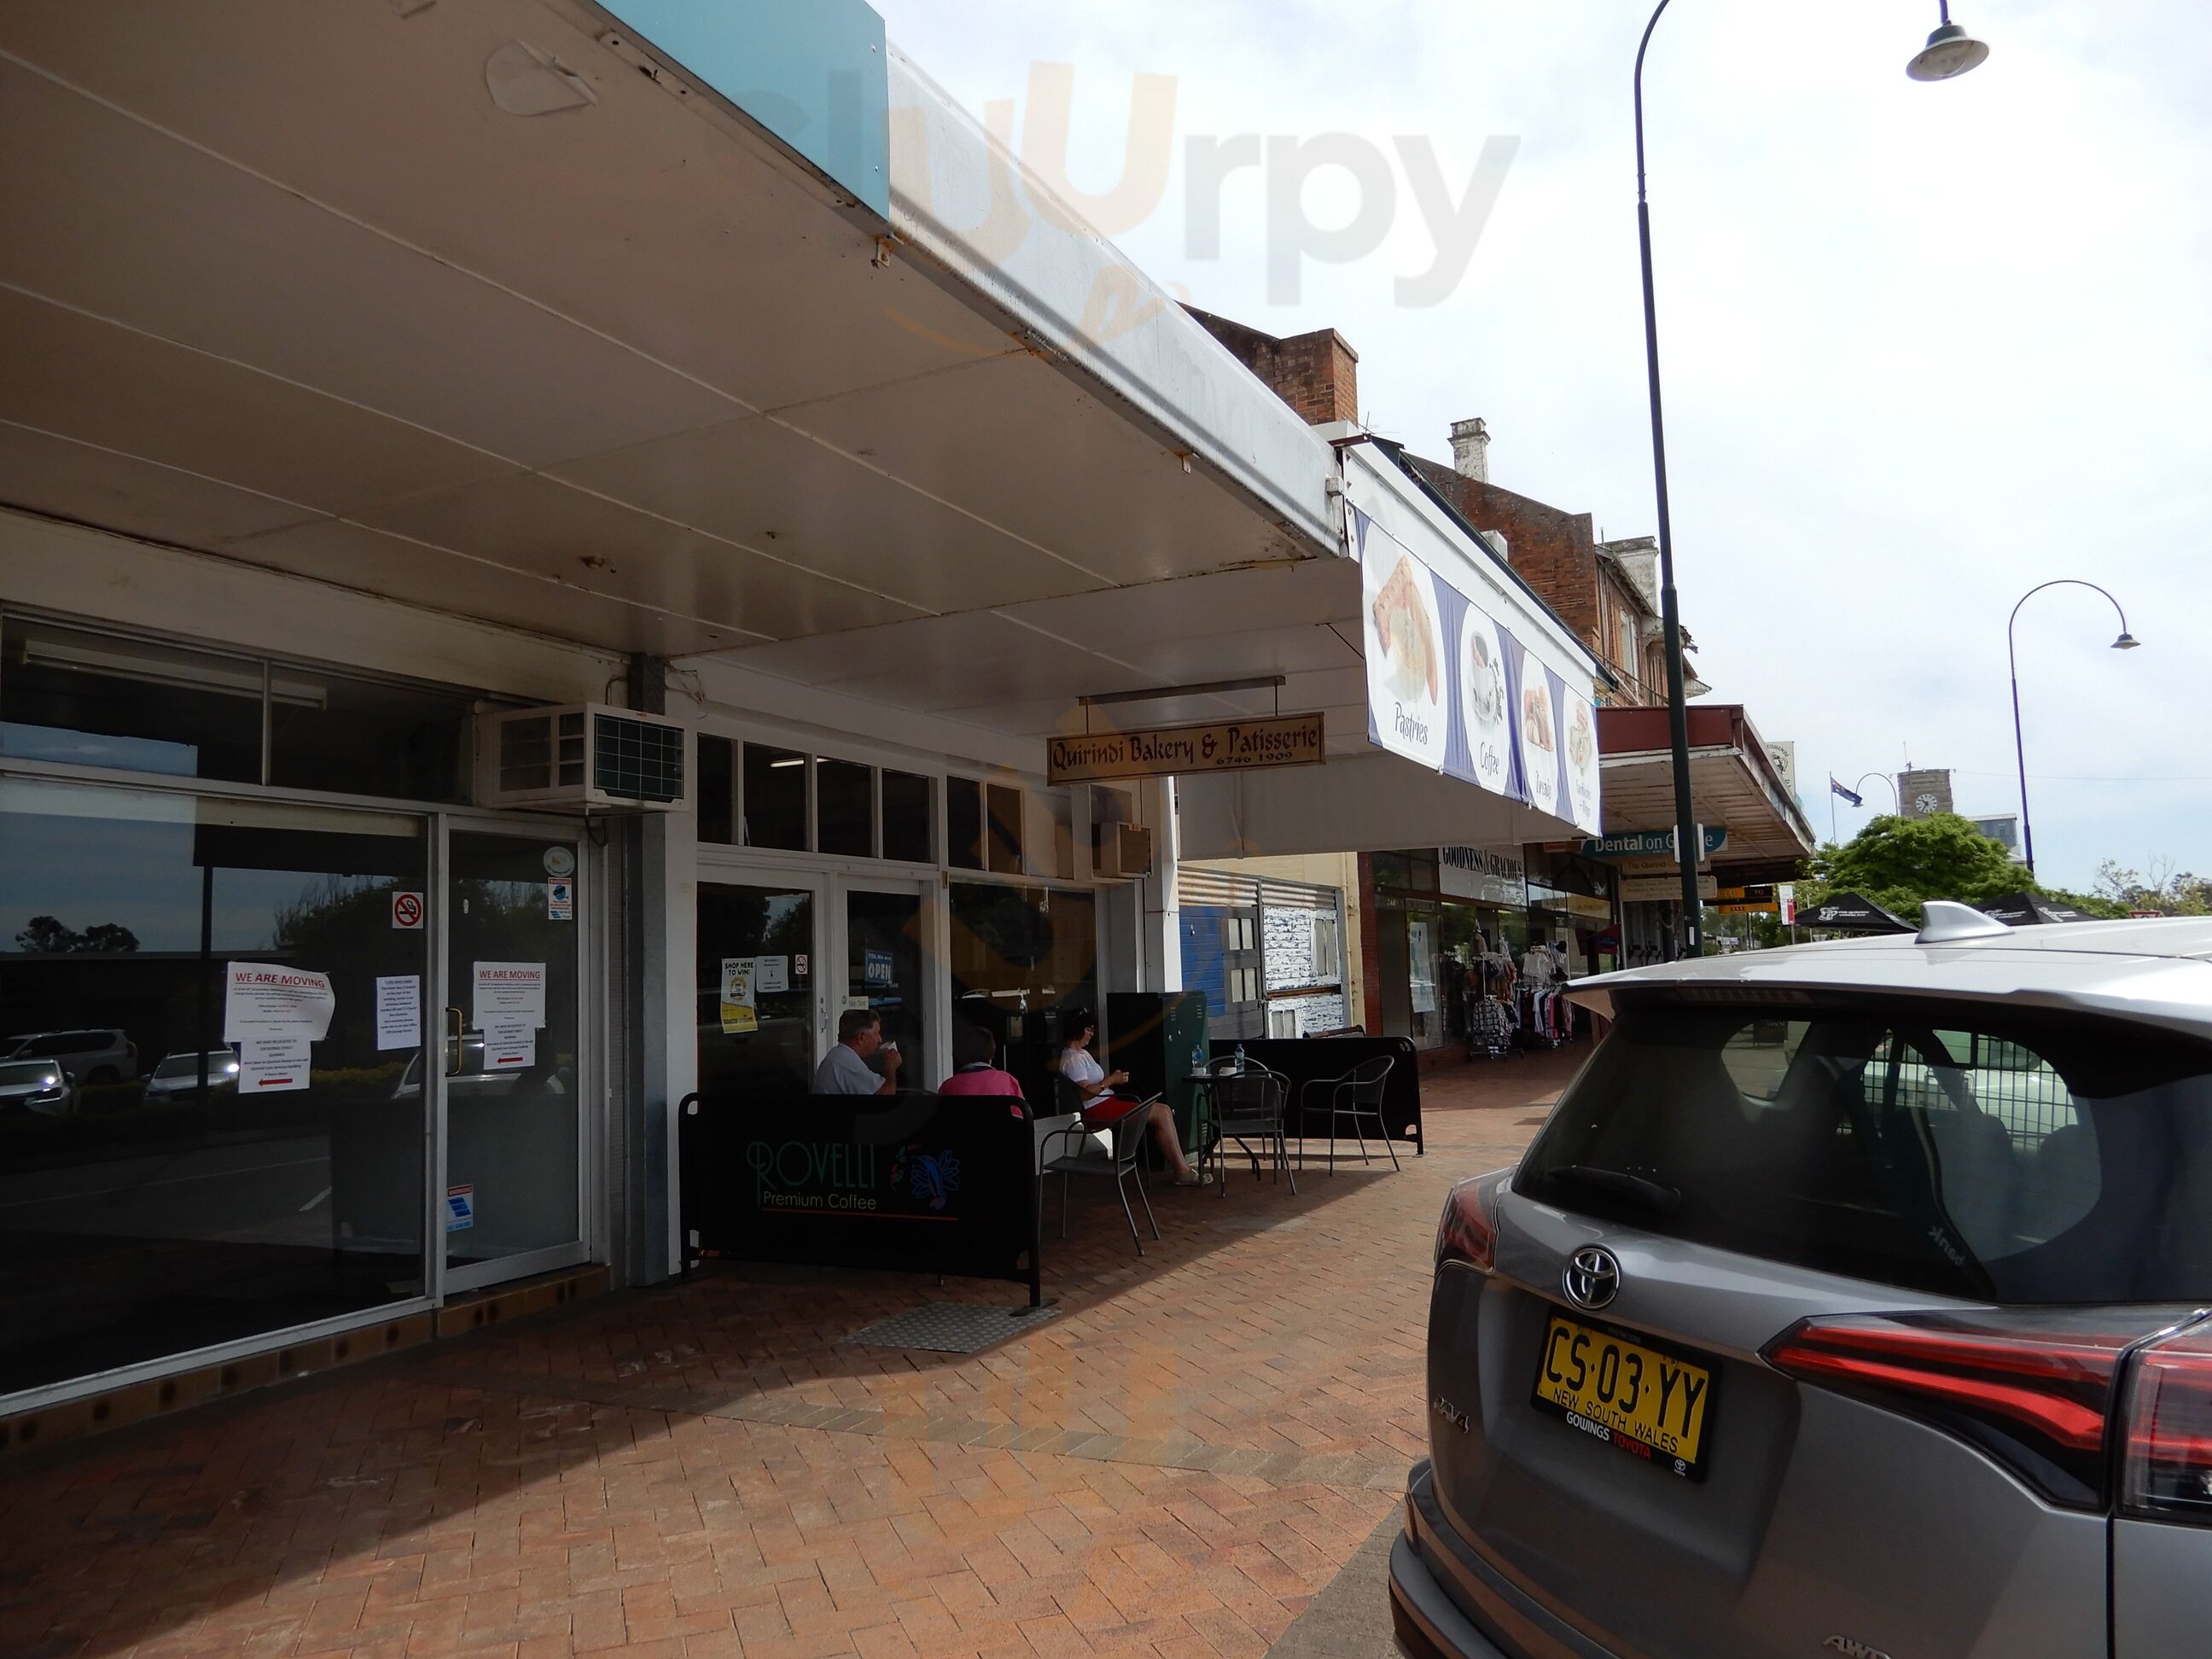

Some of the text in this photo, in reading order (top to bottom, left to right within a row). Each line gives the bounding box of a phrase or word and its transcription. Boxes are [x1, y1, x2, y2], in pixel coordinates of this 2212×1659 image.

[1394, 701, 1429, 743] Pastries
[1053, 724, 1317, 771] Quirindi Bakery & Patisserie
[1217, 751, 1293, 766] 6746 1909
[1480, 741, 1499, 776] Coffee
[1594, 834, 1644, 853] Dental
[1646, 837, 1663, 850] on
[1442, 847, 1523, 880] GOODNESS & GRACIOUS
[236, 972, 325, 988] WE ARE MOVING
[479, 970, 541, 979] WE ARE MOVING
[868, 962, 892, 981] OPEN
[746, 1140, 876, 1207] ROVELLI
[764, 1190, 877, 1209] Premium Coffee
[1433, 1393, 1470, 1435] RAV4
[1553, 1387, 1679, 1453] NEW SOUTH WALES
[1566, 1411, 1652, 1461] GOWINGS TOYOTA
